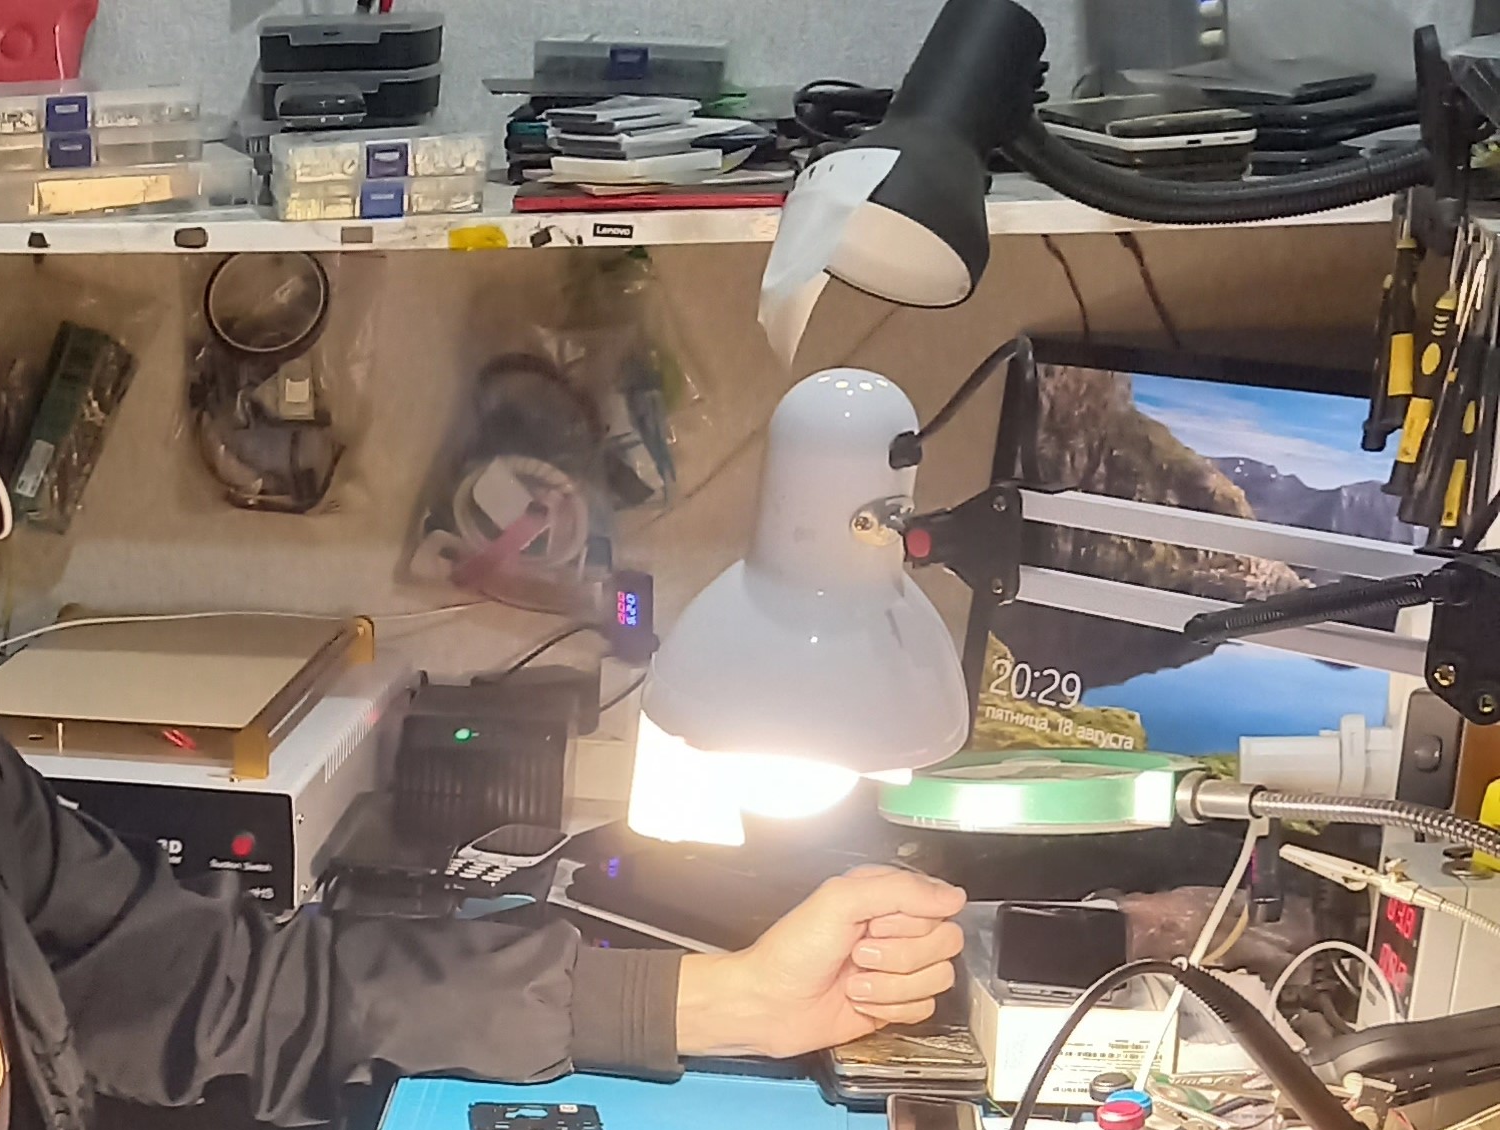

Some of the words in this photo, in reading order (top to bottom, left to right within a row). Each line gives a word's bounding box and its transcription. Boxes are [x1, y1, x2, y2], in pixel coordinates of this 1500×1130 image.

[596, 225, 631, 236] Lenovo
[989, 658, 1083, 710] 20:29
[985, 705, 1051, 734] пятница,
[1057, 716, 1073, 736] 18
[1076, 725, 1135, 750] августа
